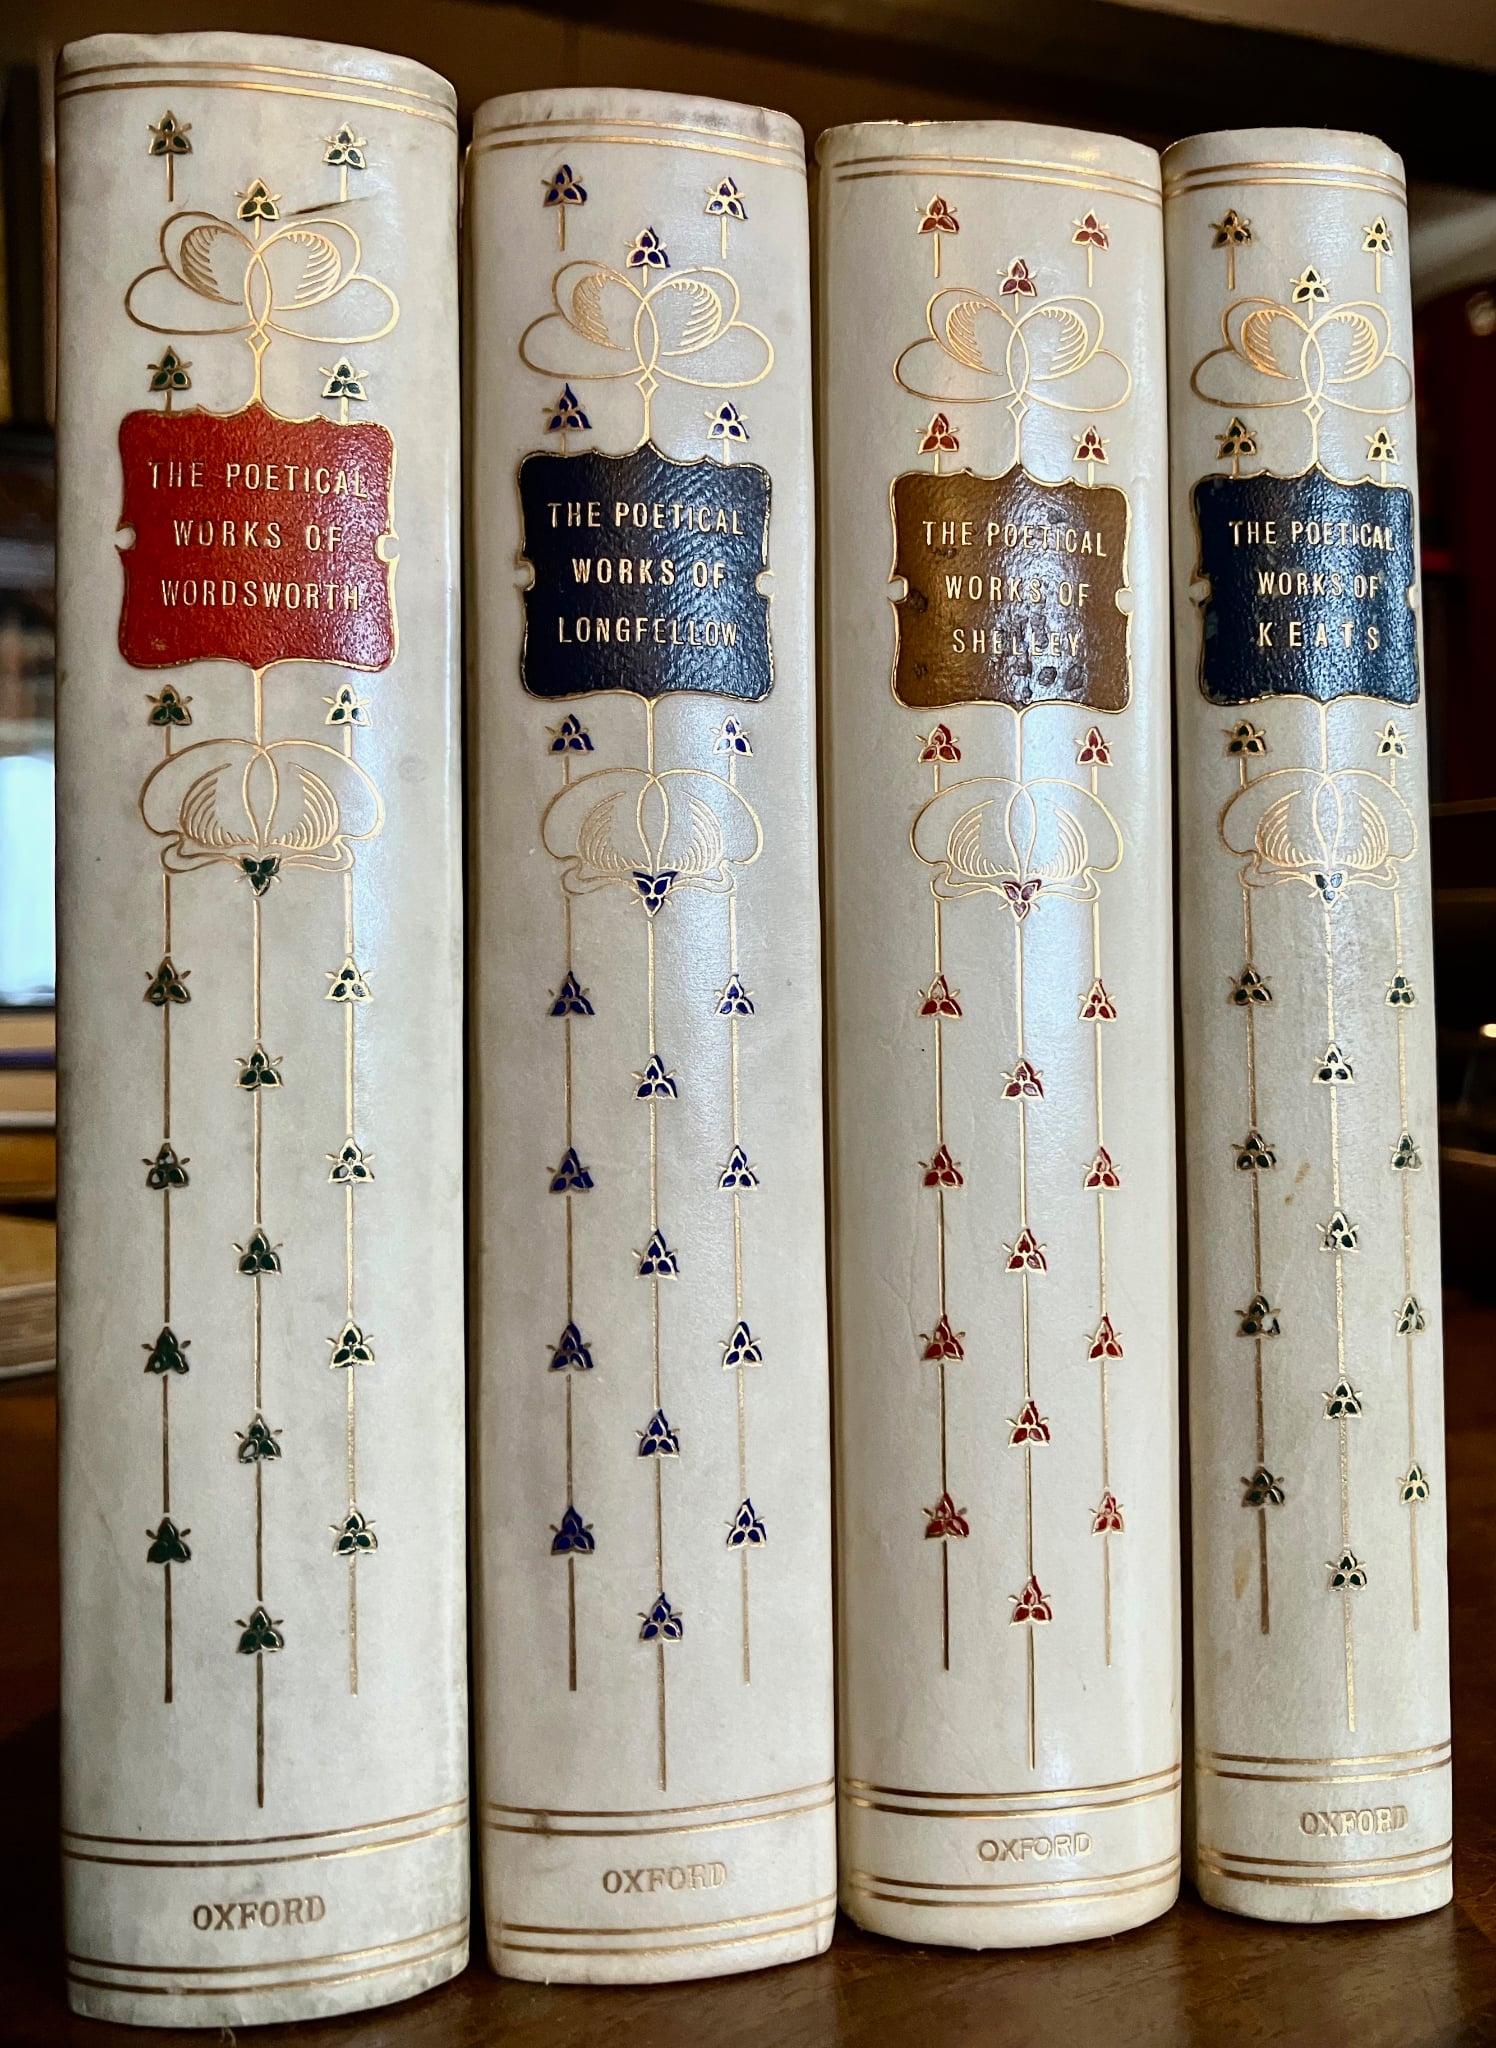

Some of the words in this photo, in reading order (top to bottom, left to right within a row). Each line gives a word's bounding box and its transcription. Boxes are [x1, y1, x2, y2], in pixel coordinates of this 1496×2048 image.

[149, 462, 205, 489] THE
[226, 463, 368, 499] POETICAL
[548, 502, 600, 529] THE
[615, 503, 744, 535] POETICAL
[173, 520, 281, 549] WORKS
[305, 525, 342, 552] OF
[922, 521, 973, 546] THE
[987, 523, 1107, 557] POETICAL
[1229, 521, 1277, 545] THE
[1291, 521, 1395, 551] POETICAL
[572, 558, 676, 586] WORKS
[692, 561, 726, 589] OF
[1258, 572, 1343, 597] WORKS
[1353, 575, 1379, 599] OF
[161, 579, 360, 612] WORDSWORTH
[945, 575, 1043, 603] WORKS
[1059, 583, 1090, 607] OF
[558, 617, 738, 647] LONGFELLOW
[952, 629, 1080, 657] SHELLEY
[1258, 622, 1380, 650] KEATS
[1299, 1805, 1408, 1837] OXFORD
[977, 1832, 1093, 1862] OXFORD
[602, 1862, 728, 1894] OXFORD
[193, 1895, 326, 1931] OXFORD
